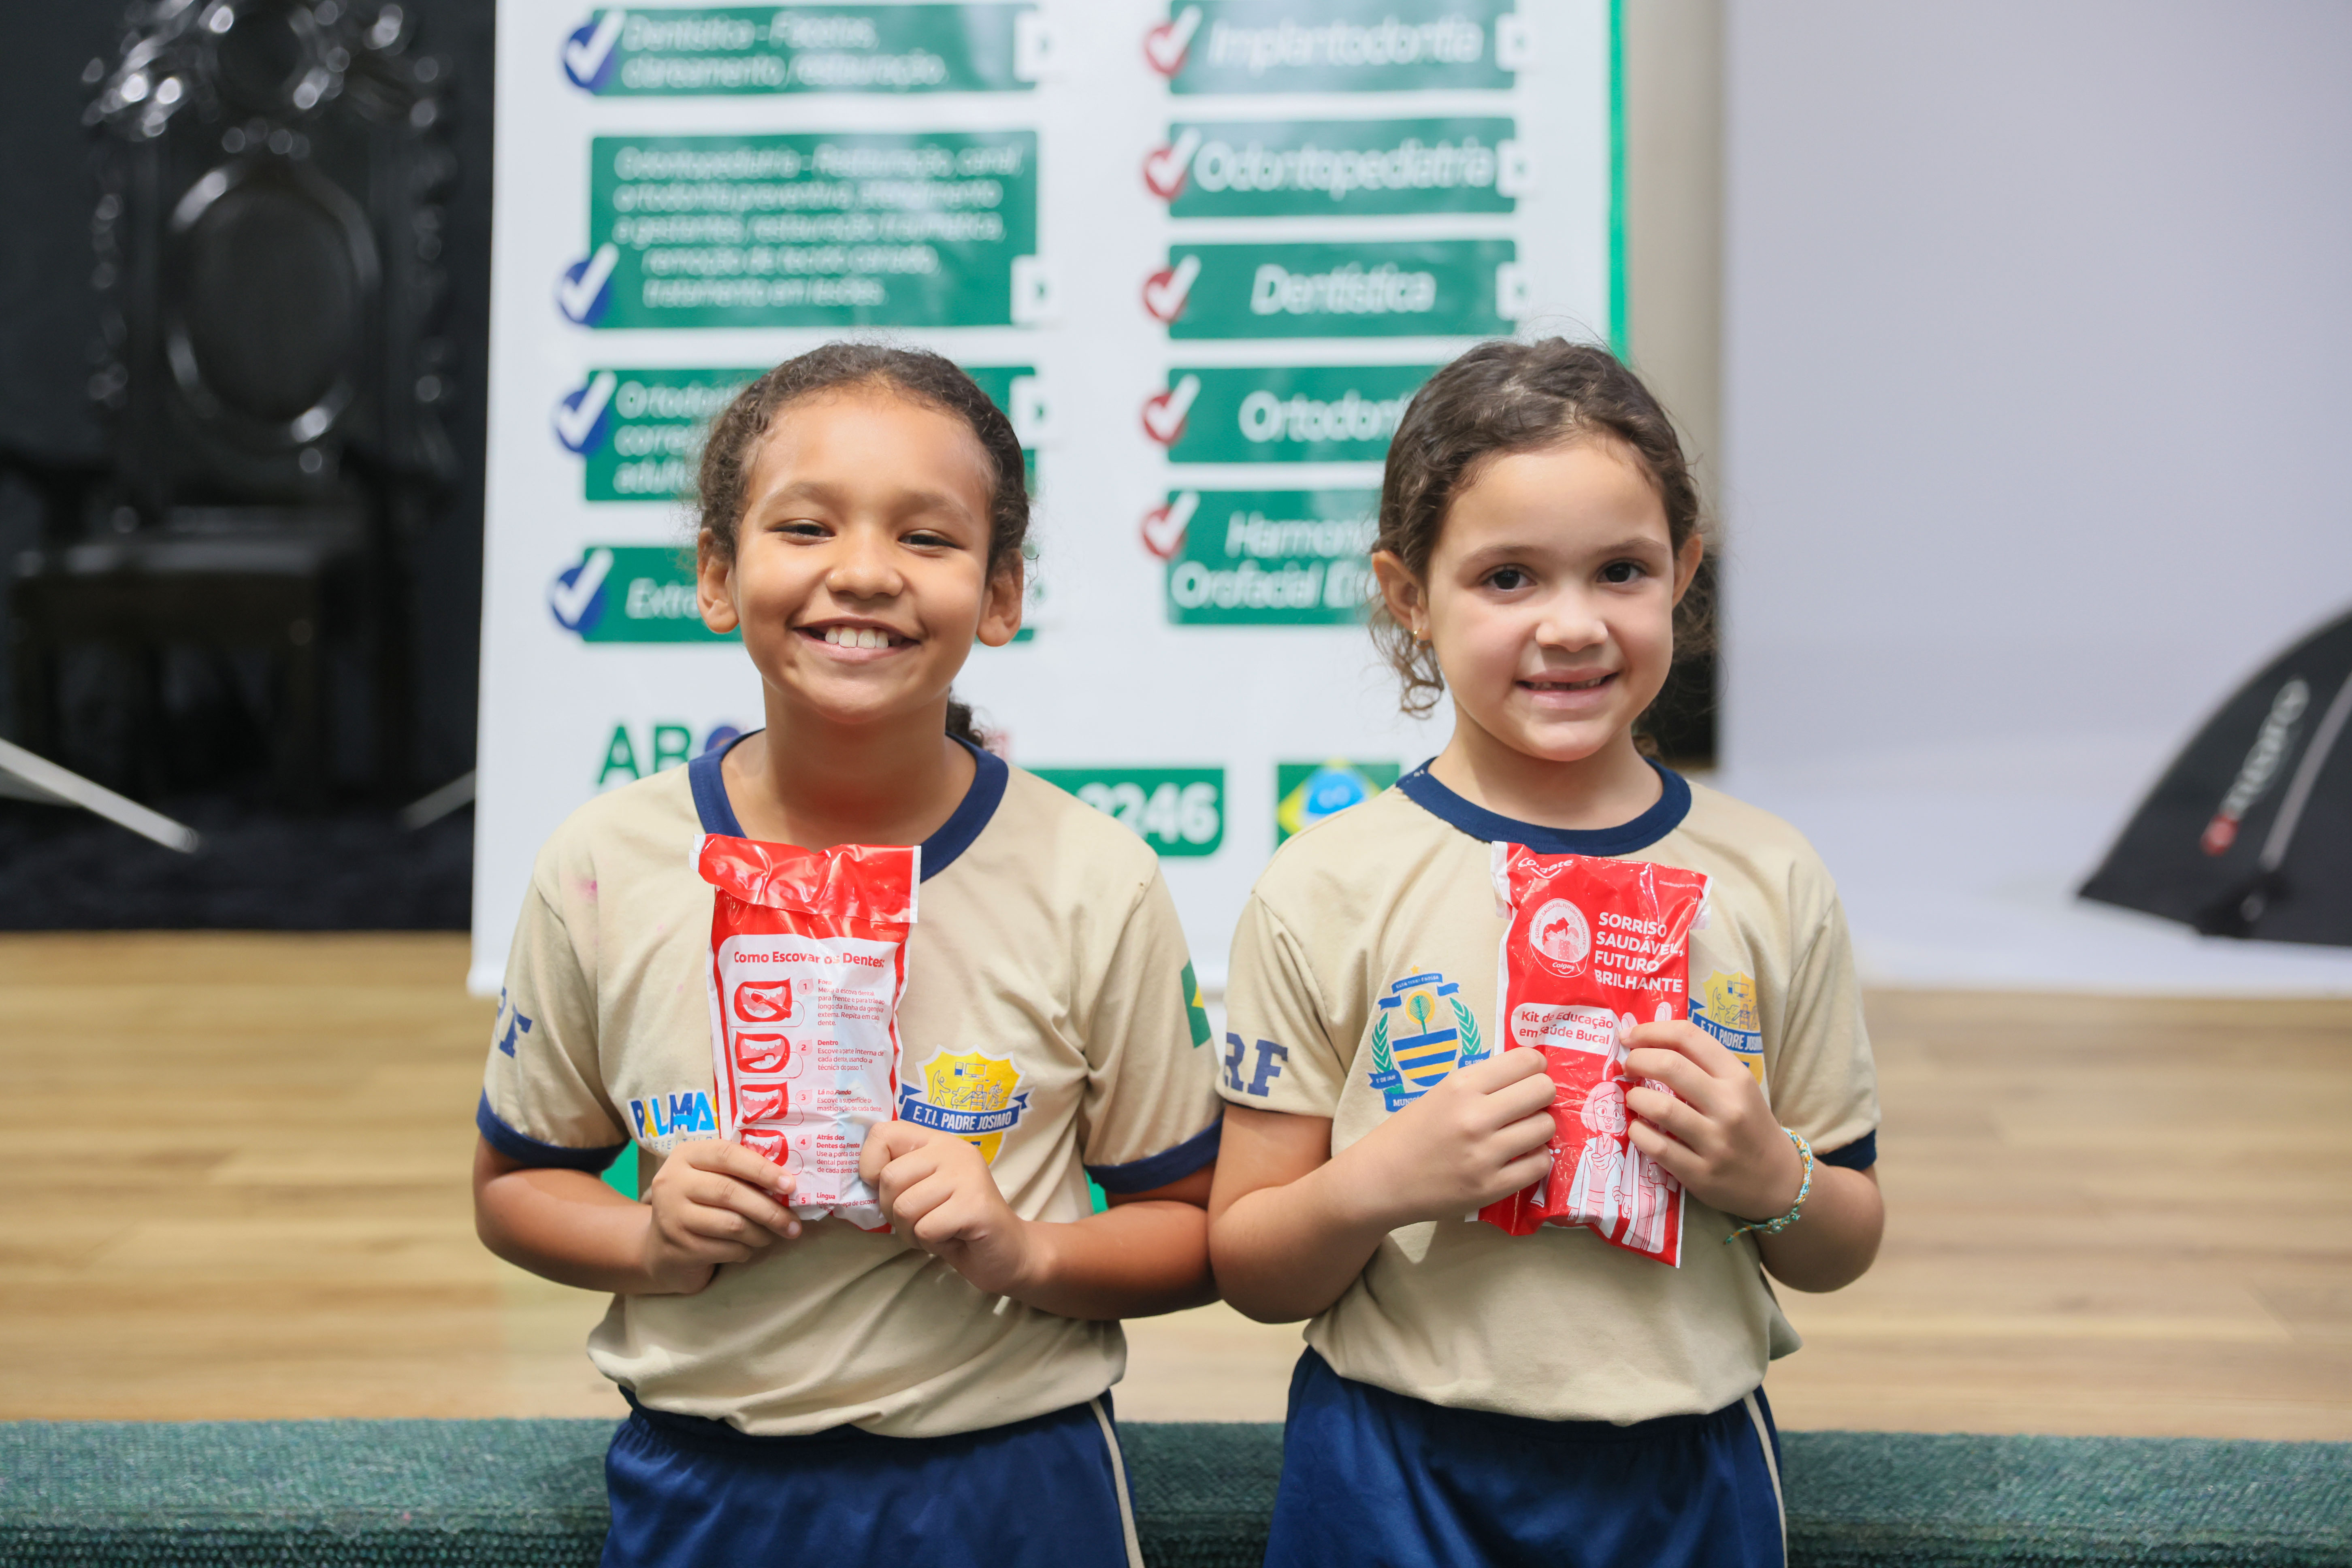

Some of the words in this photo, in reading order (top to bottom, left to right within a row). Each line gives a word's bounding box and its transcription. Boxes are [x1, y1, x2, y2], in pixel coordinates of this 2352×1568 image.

[1193, 136, 1496, 201] Odontopediatria
[1251, 261, 1437, 315] Dentística
[1598, 912, 1667, 938] SORRISO
[1596, 931, 1683, 957] SAUDÁVEL,
[734, 951, 769, 963] Como
[772, 951, 820, 963] Escovar
[824, 955, 840, 965] os
[843, 952, 884, 968] Dentes:
[1594, 950, 1660, 972] FUTURO
[1594, 969, 1683, 993] BRILHANTE
[1521, 1011, 1540, 1023] Kit
[1542, 1013, 1555, 1023] de
[1555, 1012, 1613, 1030] Educação
[1519, 1028, 1538, 1038] em
[1576, 1030, 1609, 1045] Bucal
[1719, 1029, 1745, 1050] PADRE
[855, 1048, 877, 1056] interna
[912, 1105, 938, 1127] E.T.I.
[941, 1112, 978, 1131] PADRE
[977, 1111, 1012, 1130] JOSIMO
[816, 1192, 836, 1200] Língua
